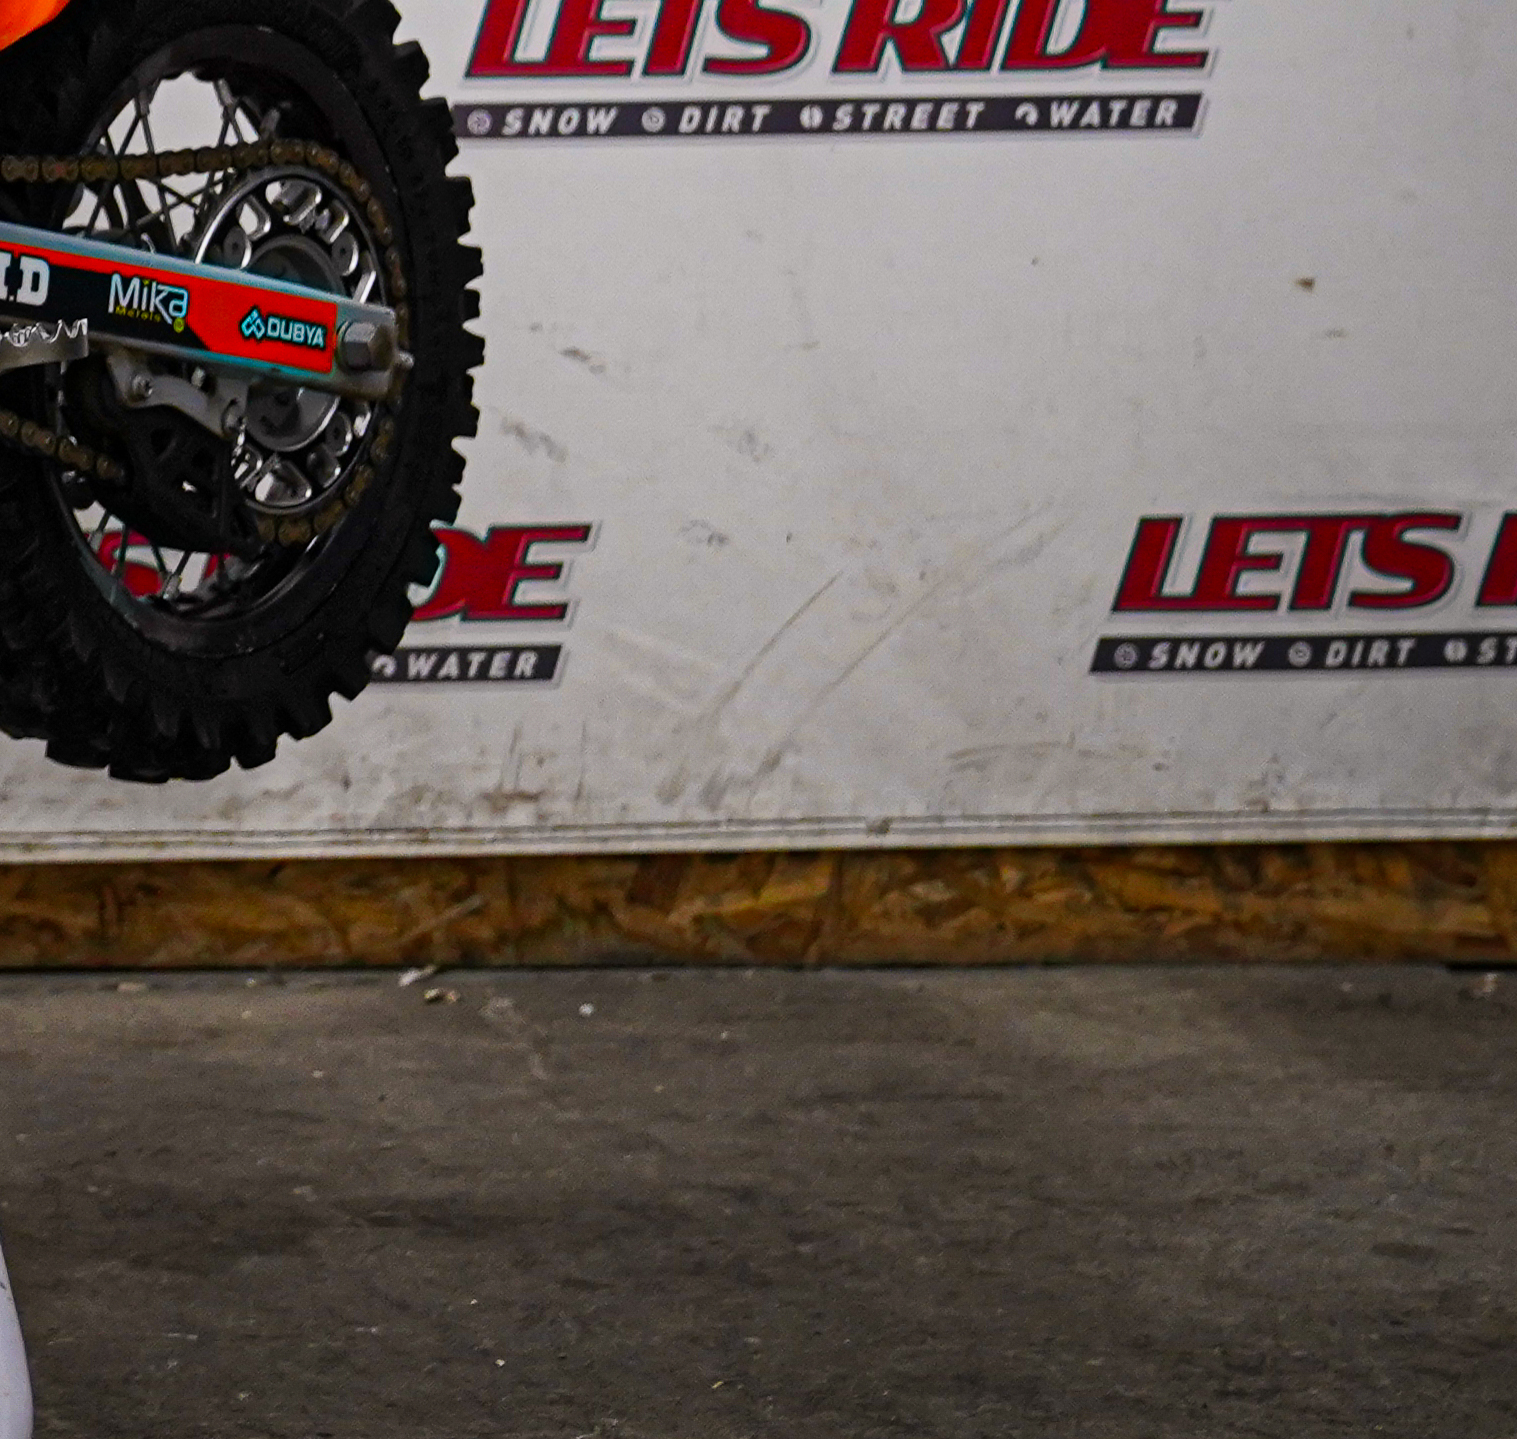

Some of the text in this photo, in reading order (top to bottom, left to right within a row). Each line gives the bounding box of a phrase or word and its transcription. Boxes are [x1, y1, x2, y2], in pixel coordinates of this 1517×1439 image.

[504, 98, 1178, 136] SNOW DIRT STREET WATER
[108, 273, 189, 325] Mika
[267, 316, 325, 348] DUBYA
[1113, 512, 1462, 612] LETS
[409, 652, 539, 680] WATER
[1148, 638, 1418, 669] SNOW DIRT
